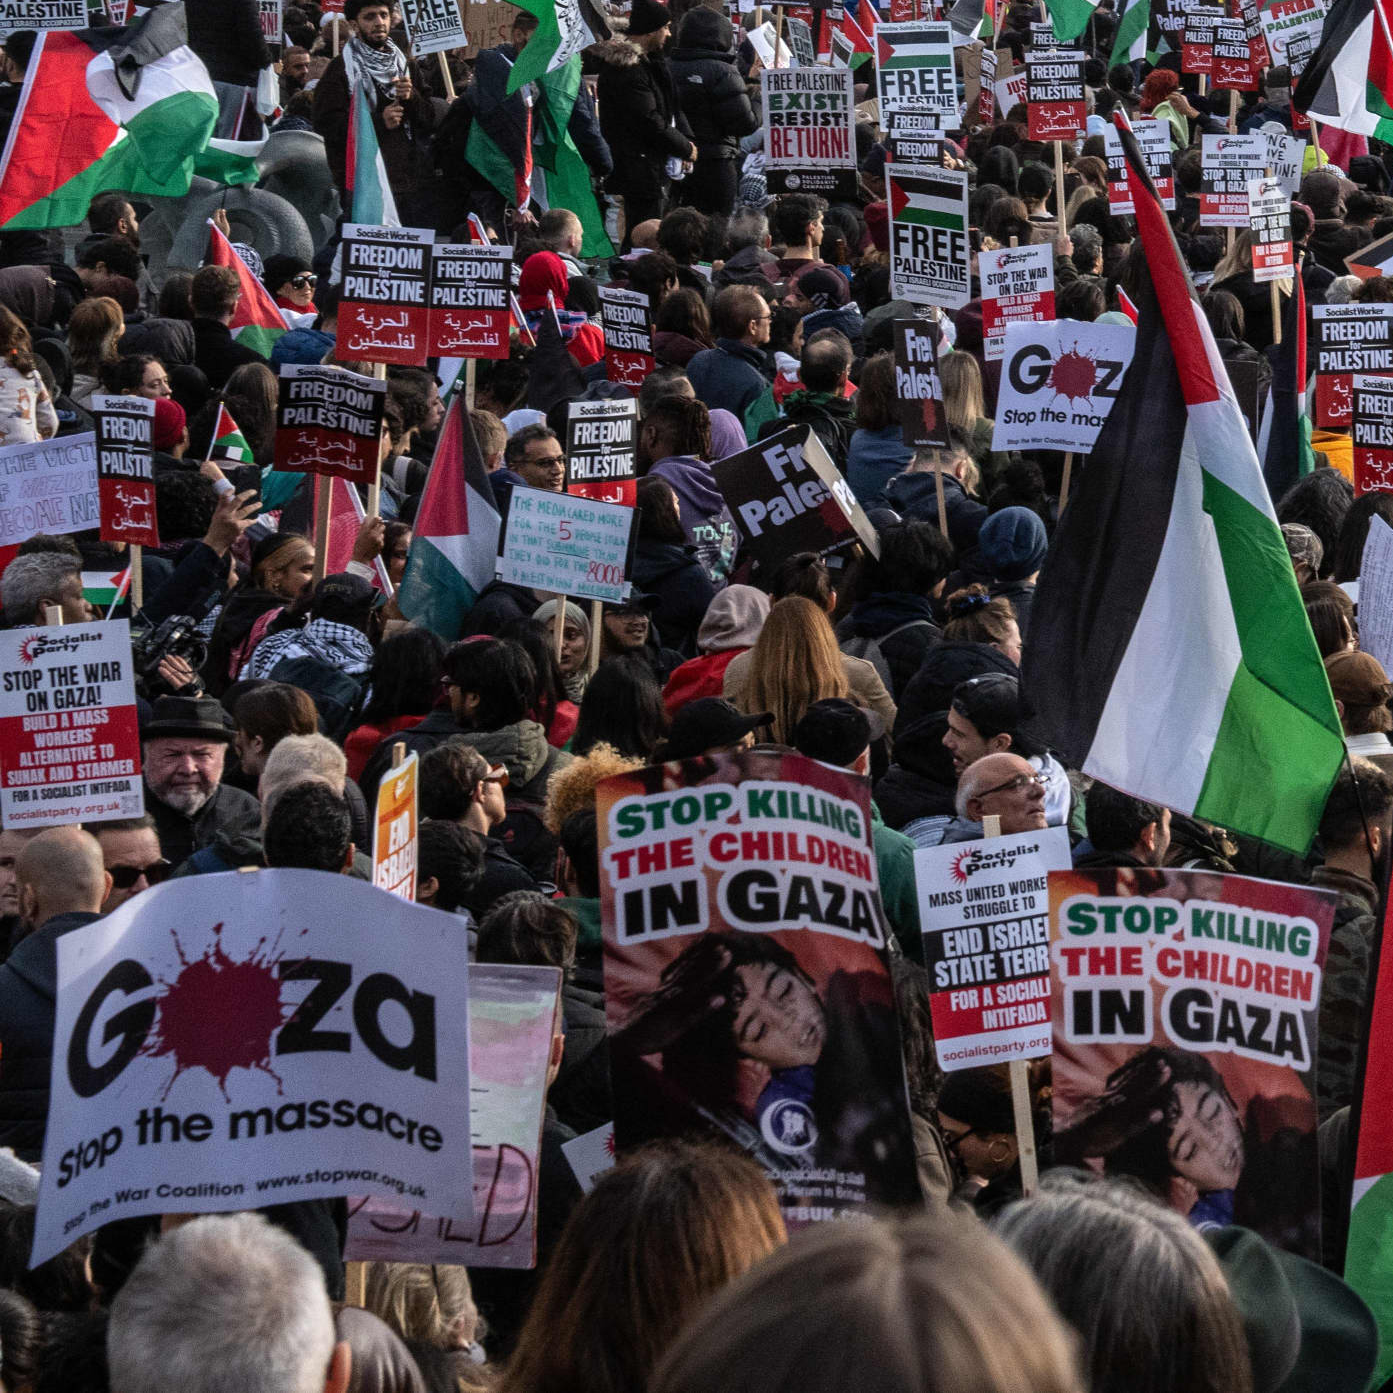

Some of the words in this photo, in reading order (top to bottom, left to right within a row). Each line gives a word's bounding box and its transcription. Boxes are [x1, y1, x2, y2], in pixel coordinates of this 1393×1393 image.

[767, 72, 793, 91] FREE
[796, 72, 848, 91] PALESTINE
[1030, 64, 1079, 79] FREEDOM
[769, 92, 848, 111] EXIST!
[1029, 85, 1083, 101] PALESTINE
[771, 111, 849, 127] RESIST!
[770, 127, 850, 160] RETURN!
[349, 243, 424, 270] FREEDOM
[893, 223, 966, 265] FREE
[378, 266, 392, 279] for
[437, 260, 504, 280] FREEDOM
[893, 258, 968, 282] PALESTINE
[343, 276, 425, 303] PALESTINE
[433, 288, 507, 308] PALESTINE
[355, 308, 409, 331] الحرية
[347, 330, 416, 351] لفلسطين
[573, 419, 632, 446] FREEDOM
[570, 453, 634, 480] PALESTINE
[38, 633, 103, 649] Socialist
[3, 669, 43, 693] STOP
[48, 664, 80, 687] THE
[85, 660, 121, 683] WAR
[26, 691, 48, 713] ON
[53, 685, 102, 710] GAZA!
[23, 713, 56, 732] BUILD
[60, 711, 70, 729] A
[72, 709, 109, 726] MASS
[19, 745, 97, 768] ALTERNATIVE
[99, 743, 114, 759] TO
[7, 766, 45, 786] SUNAK
[48, 764, 73, 782] AND
[75, 759, 134, 780] STARMER
[12, 789, 30, 804] FOR
[31, 789, 38, 802] A
[40, 783, 88, 801] SOCIALIST
[90, 779, 131, 797] INTIFADA
[8, 799, 120, 823] socialistparty.org.uk
[616, 790, 734, 839] STOP
[747, 788, 862, 840] KILLING
[611, 837, 696, 881] THE
[708, 831, 873, 883] CHILDREN
[971, 843, 1040, 863] Socialist
[623, 878, 701, 938] IN
[726, 868, 881, 942] GAZA
[929, 888, 963, 909] MASS
[965, 882, 1006, 904] UNITED
[1008, 876, 1048, 898] WORKE
[963, 898, 1017, 920] STRUGGLE
[1018, 895, 1037, 912] TO
[942, 928, 987, 959] END
[989, 917, 1048, 950] ISRAE
[1065, 902, 1179, 937] STOP
[1191, 907, 1313, 959] KILLING
[935, 954, 985, 988] STATE
[988, 946, 1049, 978] TERR
[1059, 946, 1144, 977] THE
[1155, 947, 1316, 1003] CHILDREN
[950, 986, 981, 1013] FOR
[983, 985, 994, 1007] A
[996, 979, 1051, 1006] SOCIALI
[64, 959, 438, 1099] Gza
[982, 1005, 1048, 1032] INTIFADA
[1071, 989, 1147, 1037] IN
[1169, 988, 1307, 1065] GAZA
[56, 1125, 124, 1189] Stop
[136, 1106, 215, 1147] the
[228, 1097, 445, 1153] massacre
[114, 1186, 151, 1206] War
[155, 1179, 246, 1200] Coalition
[256, 1169, 428, 1200] www.stopwar.org.uk
